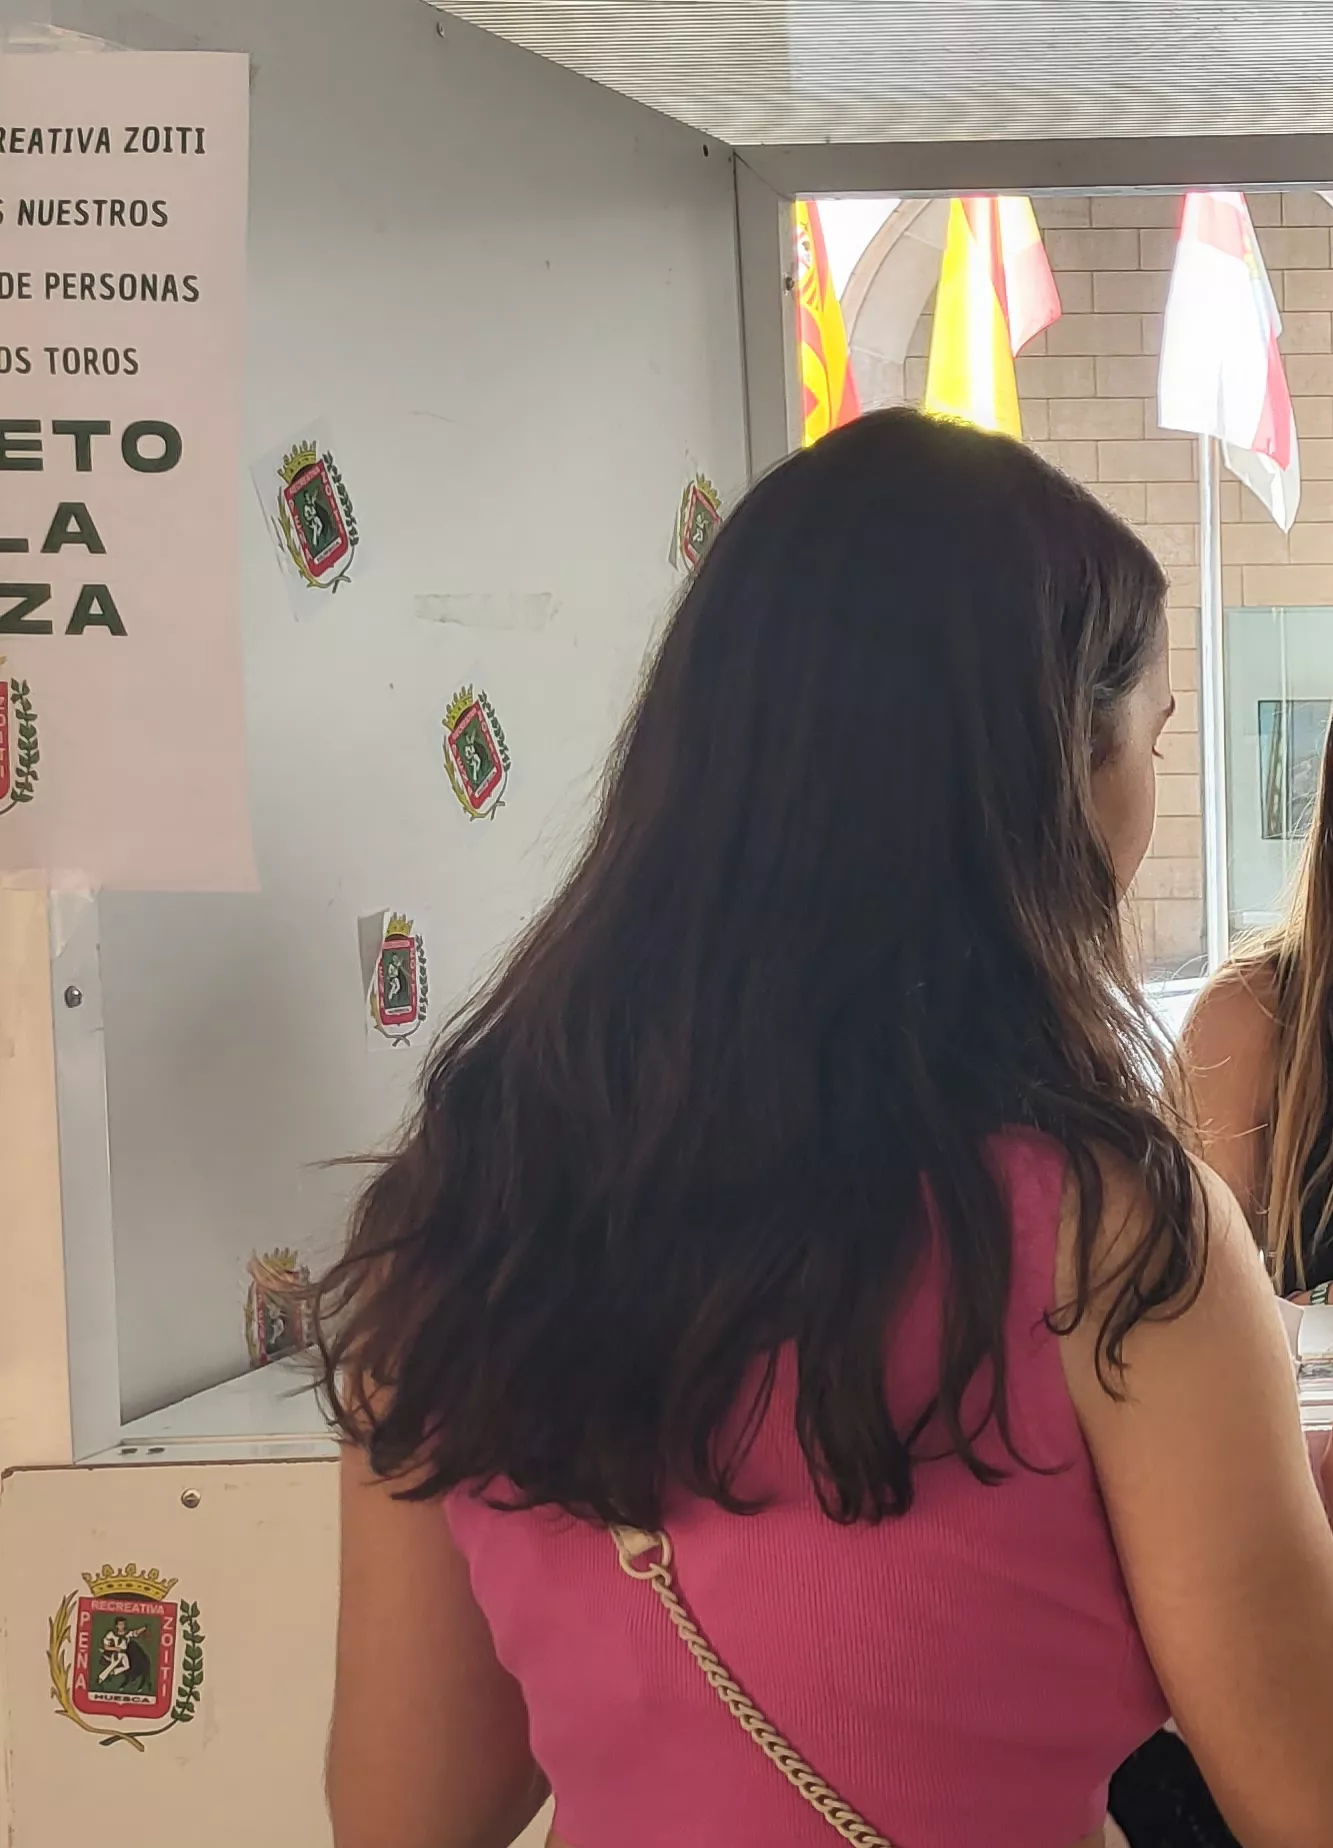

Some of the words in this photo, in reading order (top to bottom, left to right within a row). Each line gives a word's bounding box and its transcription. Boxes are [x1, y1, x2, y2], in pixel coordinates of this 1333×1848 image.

[123, 126, 206, 154] ZOITI
[17, 199, 169, 228] NUESTROS
[45, 272, 200, 302] PERSONAS
[44, 347, 139, 375] TOROS
[90, 1600, 165, 1615] RECREATIVA
[74, 1611, 91, 1690] PEÑA
[160, 1616, 174, 1697] ZOITI
[94, 1693, 151, 1704] HUESCA
